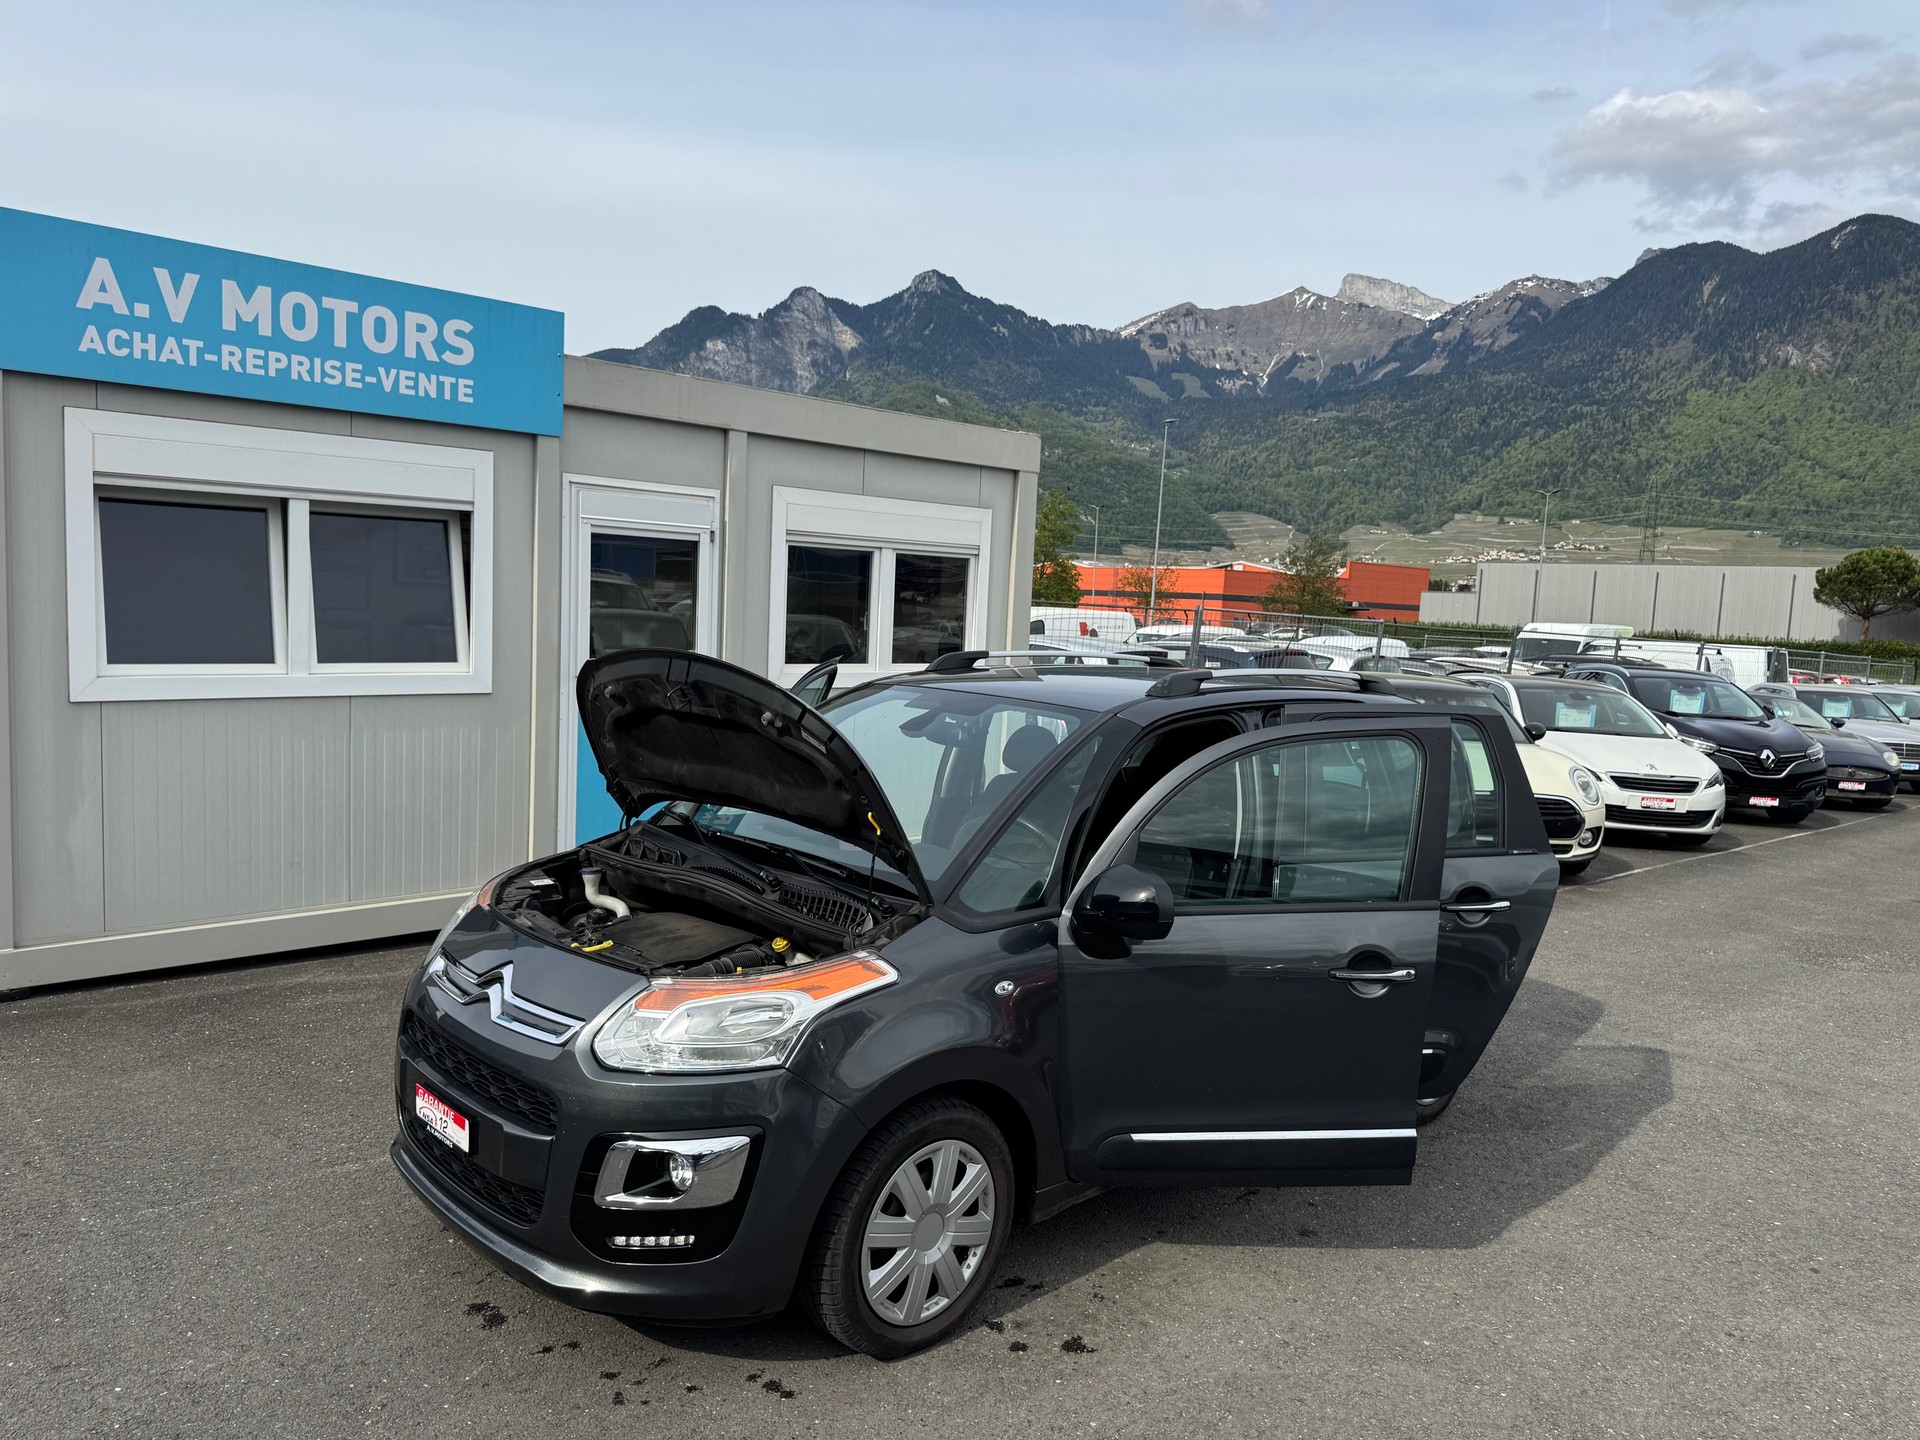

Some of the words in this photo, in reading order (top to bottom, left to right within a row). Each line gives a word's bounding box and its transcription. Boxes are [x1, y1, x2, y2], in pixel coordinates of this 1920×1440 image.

[75, 257, 200, 323] A.V
[221, 279, 475, 366] MOTORS
[78, 325, 474, 403] ACHAT-REPRISE-VENTE
[418, 1088, 455, 1121] GARANTIE
[438, 1116, 449, 1135] 12
